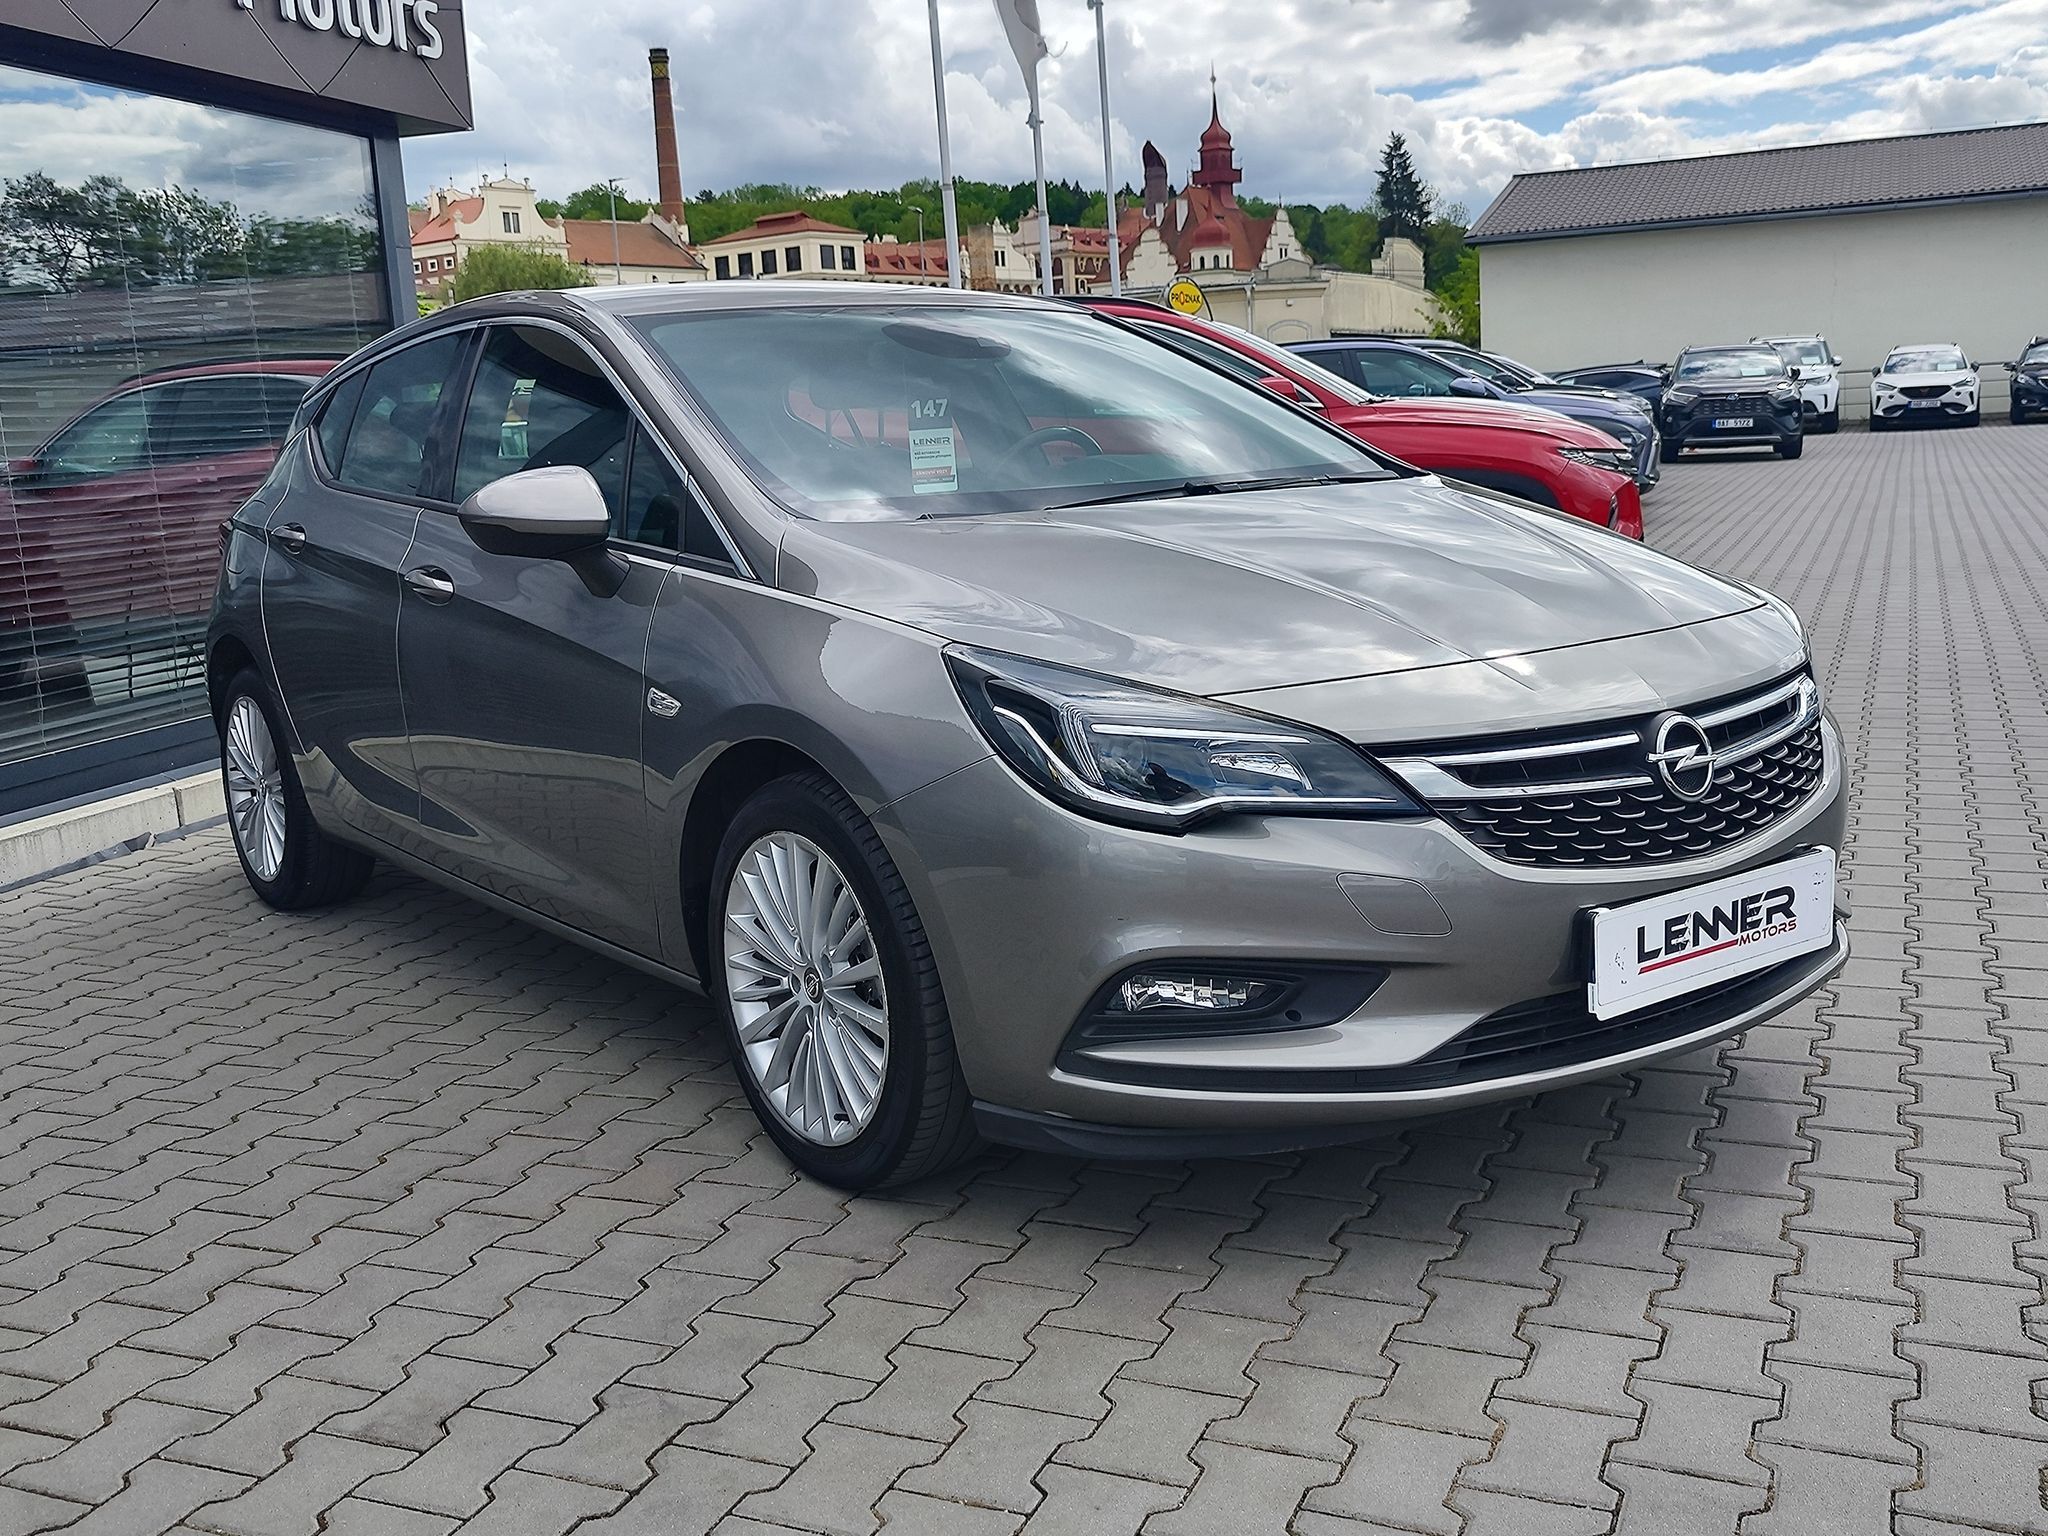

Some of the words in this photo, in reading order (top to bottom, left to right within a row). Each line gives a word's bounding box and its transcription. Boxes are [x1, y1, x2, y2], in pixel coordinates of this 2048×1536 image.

[237, 0, 443, 59] otors
[911, 398, 948, 418] 147
[913, 436, 951, 446] LENNER
[1637, 886, 1797, 964] LENNER
[1738, 918, 1797, 947] MOTORS
